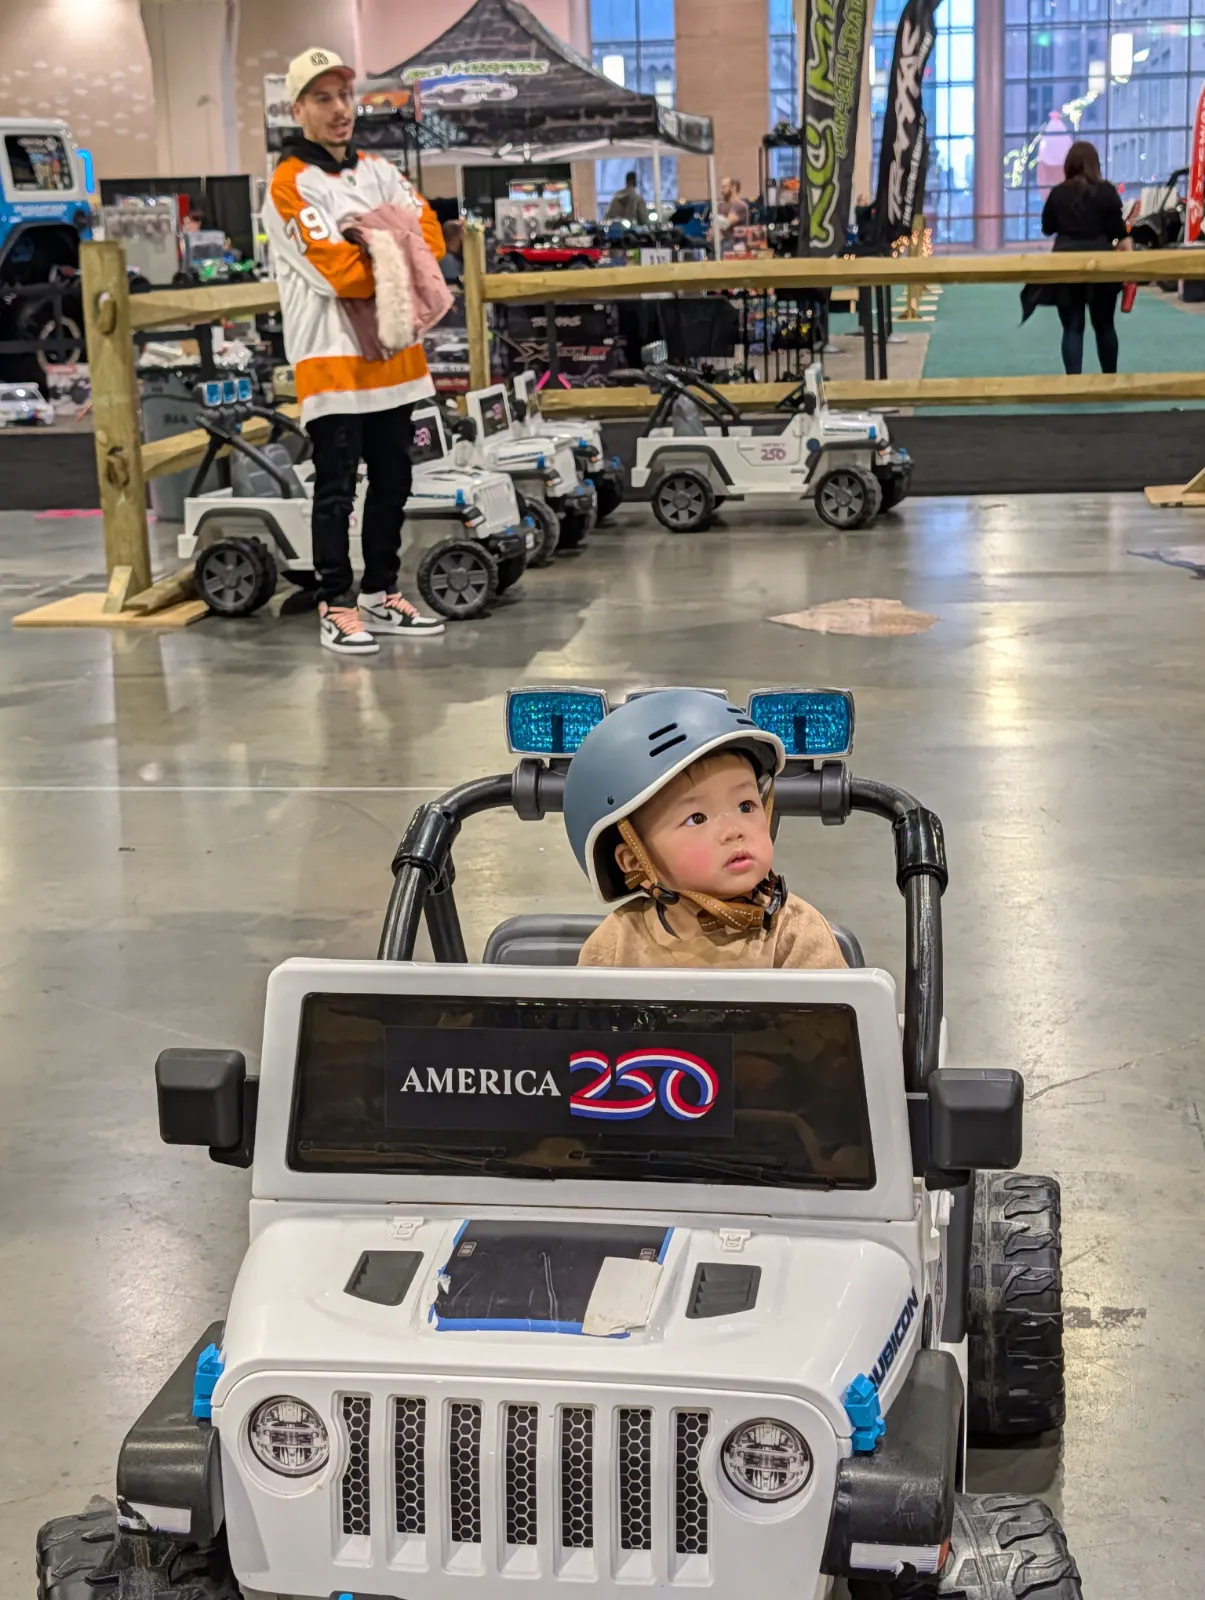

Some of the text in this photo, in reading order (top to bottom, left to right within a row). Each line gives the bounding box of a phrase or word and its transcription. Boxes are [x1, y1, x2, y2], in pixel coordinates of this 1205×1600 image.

[887, 19, 920, 226] TRAXXAS
[283, 206, 331, 256] 79
[400, 1047, 719, 1121] AMERICA 250
